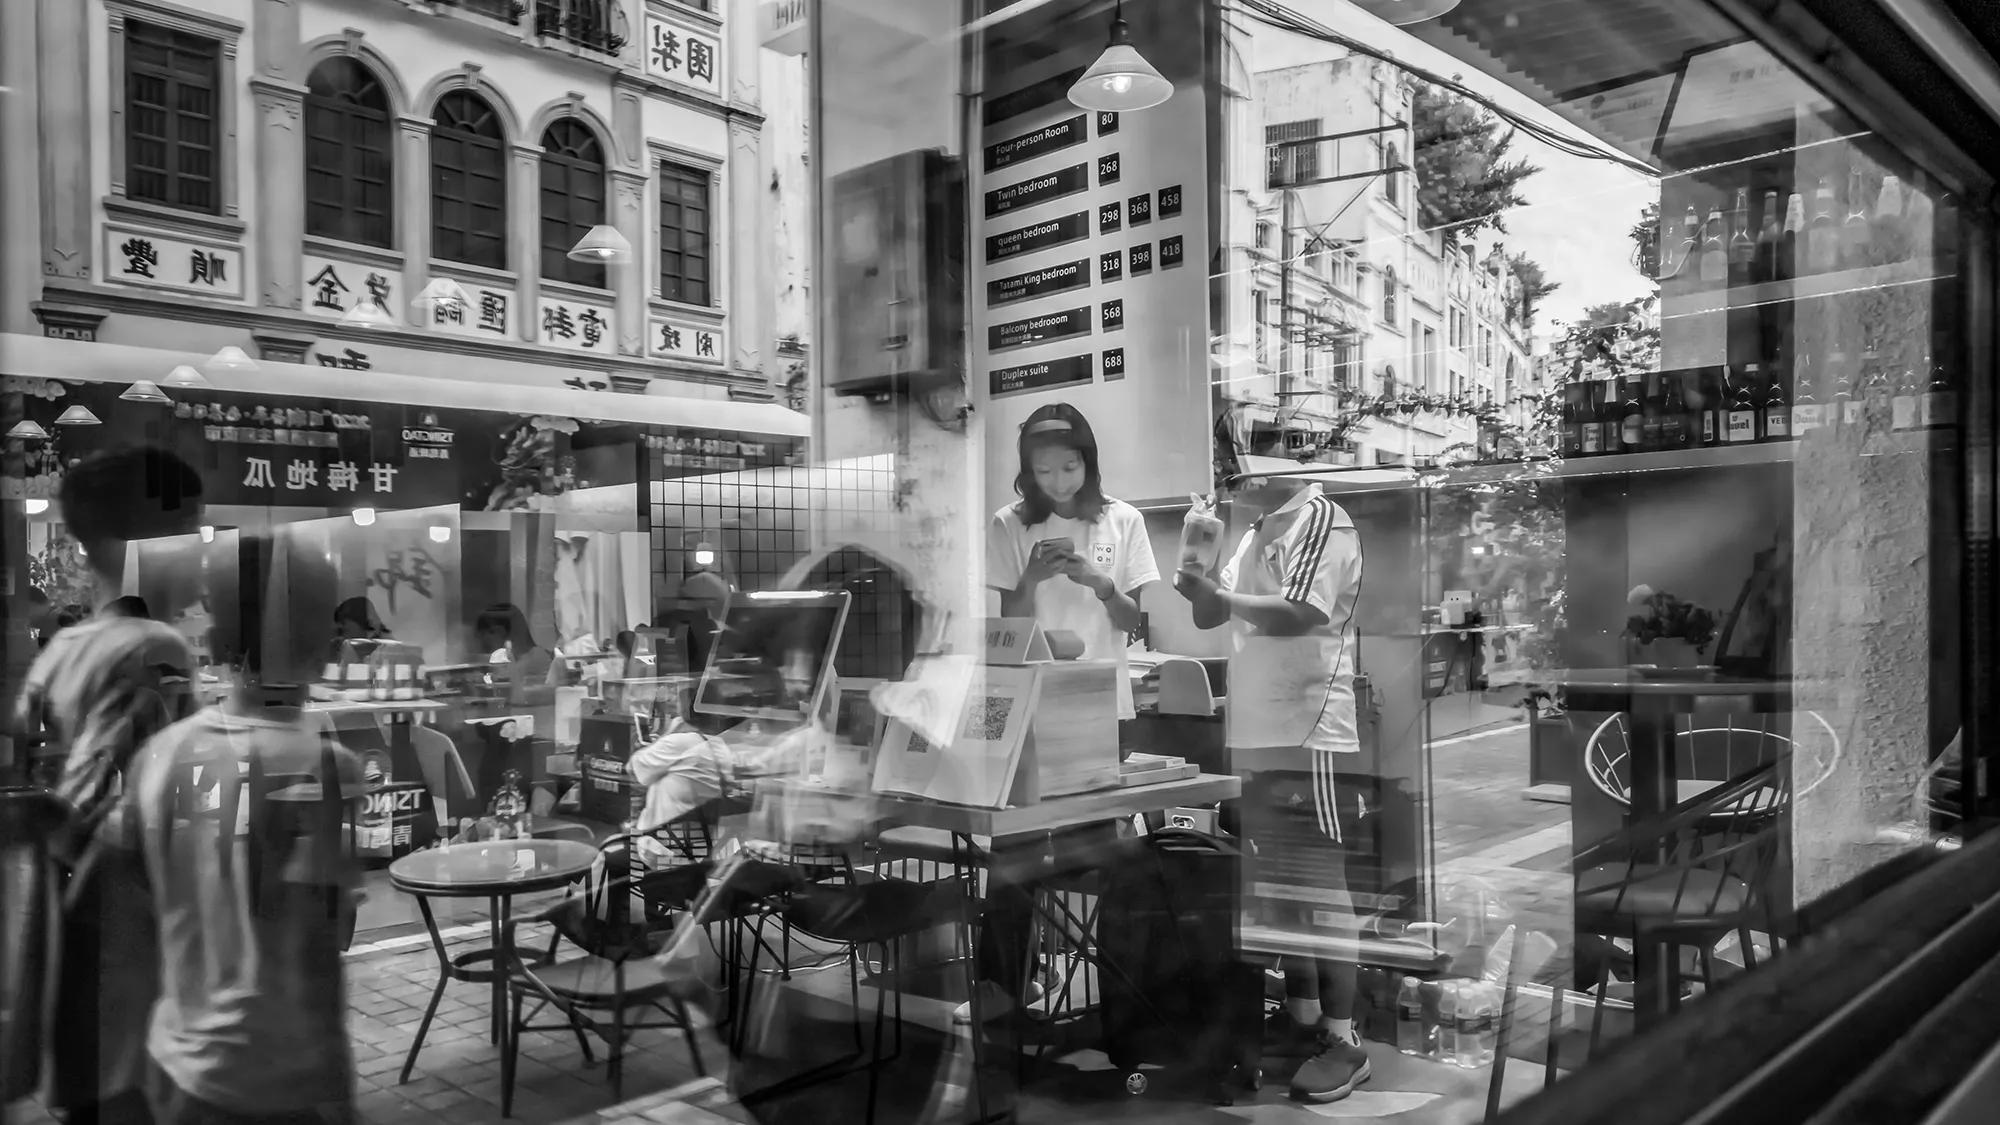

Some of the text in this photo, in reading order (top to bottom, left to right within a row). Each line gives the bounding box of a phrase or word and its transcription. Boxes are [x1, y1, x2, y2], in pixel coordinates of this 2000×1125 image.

[1101, 112, 1114, 126] 80
[996, 124, 1069, 155] Four-person Room
[1100, 160, 1118, 175] 268
[997, 176, 1058, 200] Twin bedroom
[1102, 194, 1180, 224] 298 368 458
[1023, 222, 1060, 239] bedroom
[1102, 243, 1181, 273] 318 398 418
[1000, 265, 1077, 290] Tatami King bedroom
[1103, 306, 1121, 320] 568
[1001, 323, 1028, 335] Balcony
[1104, 355, 1122, 368] 688
[1001, 364, 1049, 380] Duplex suite
